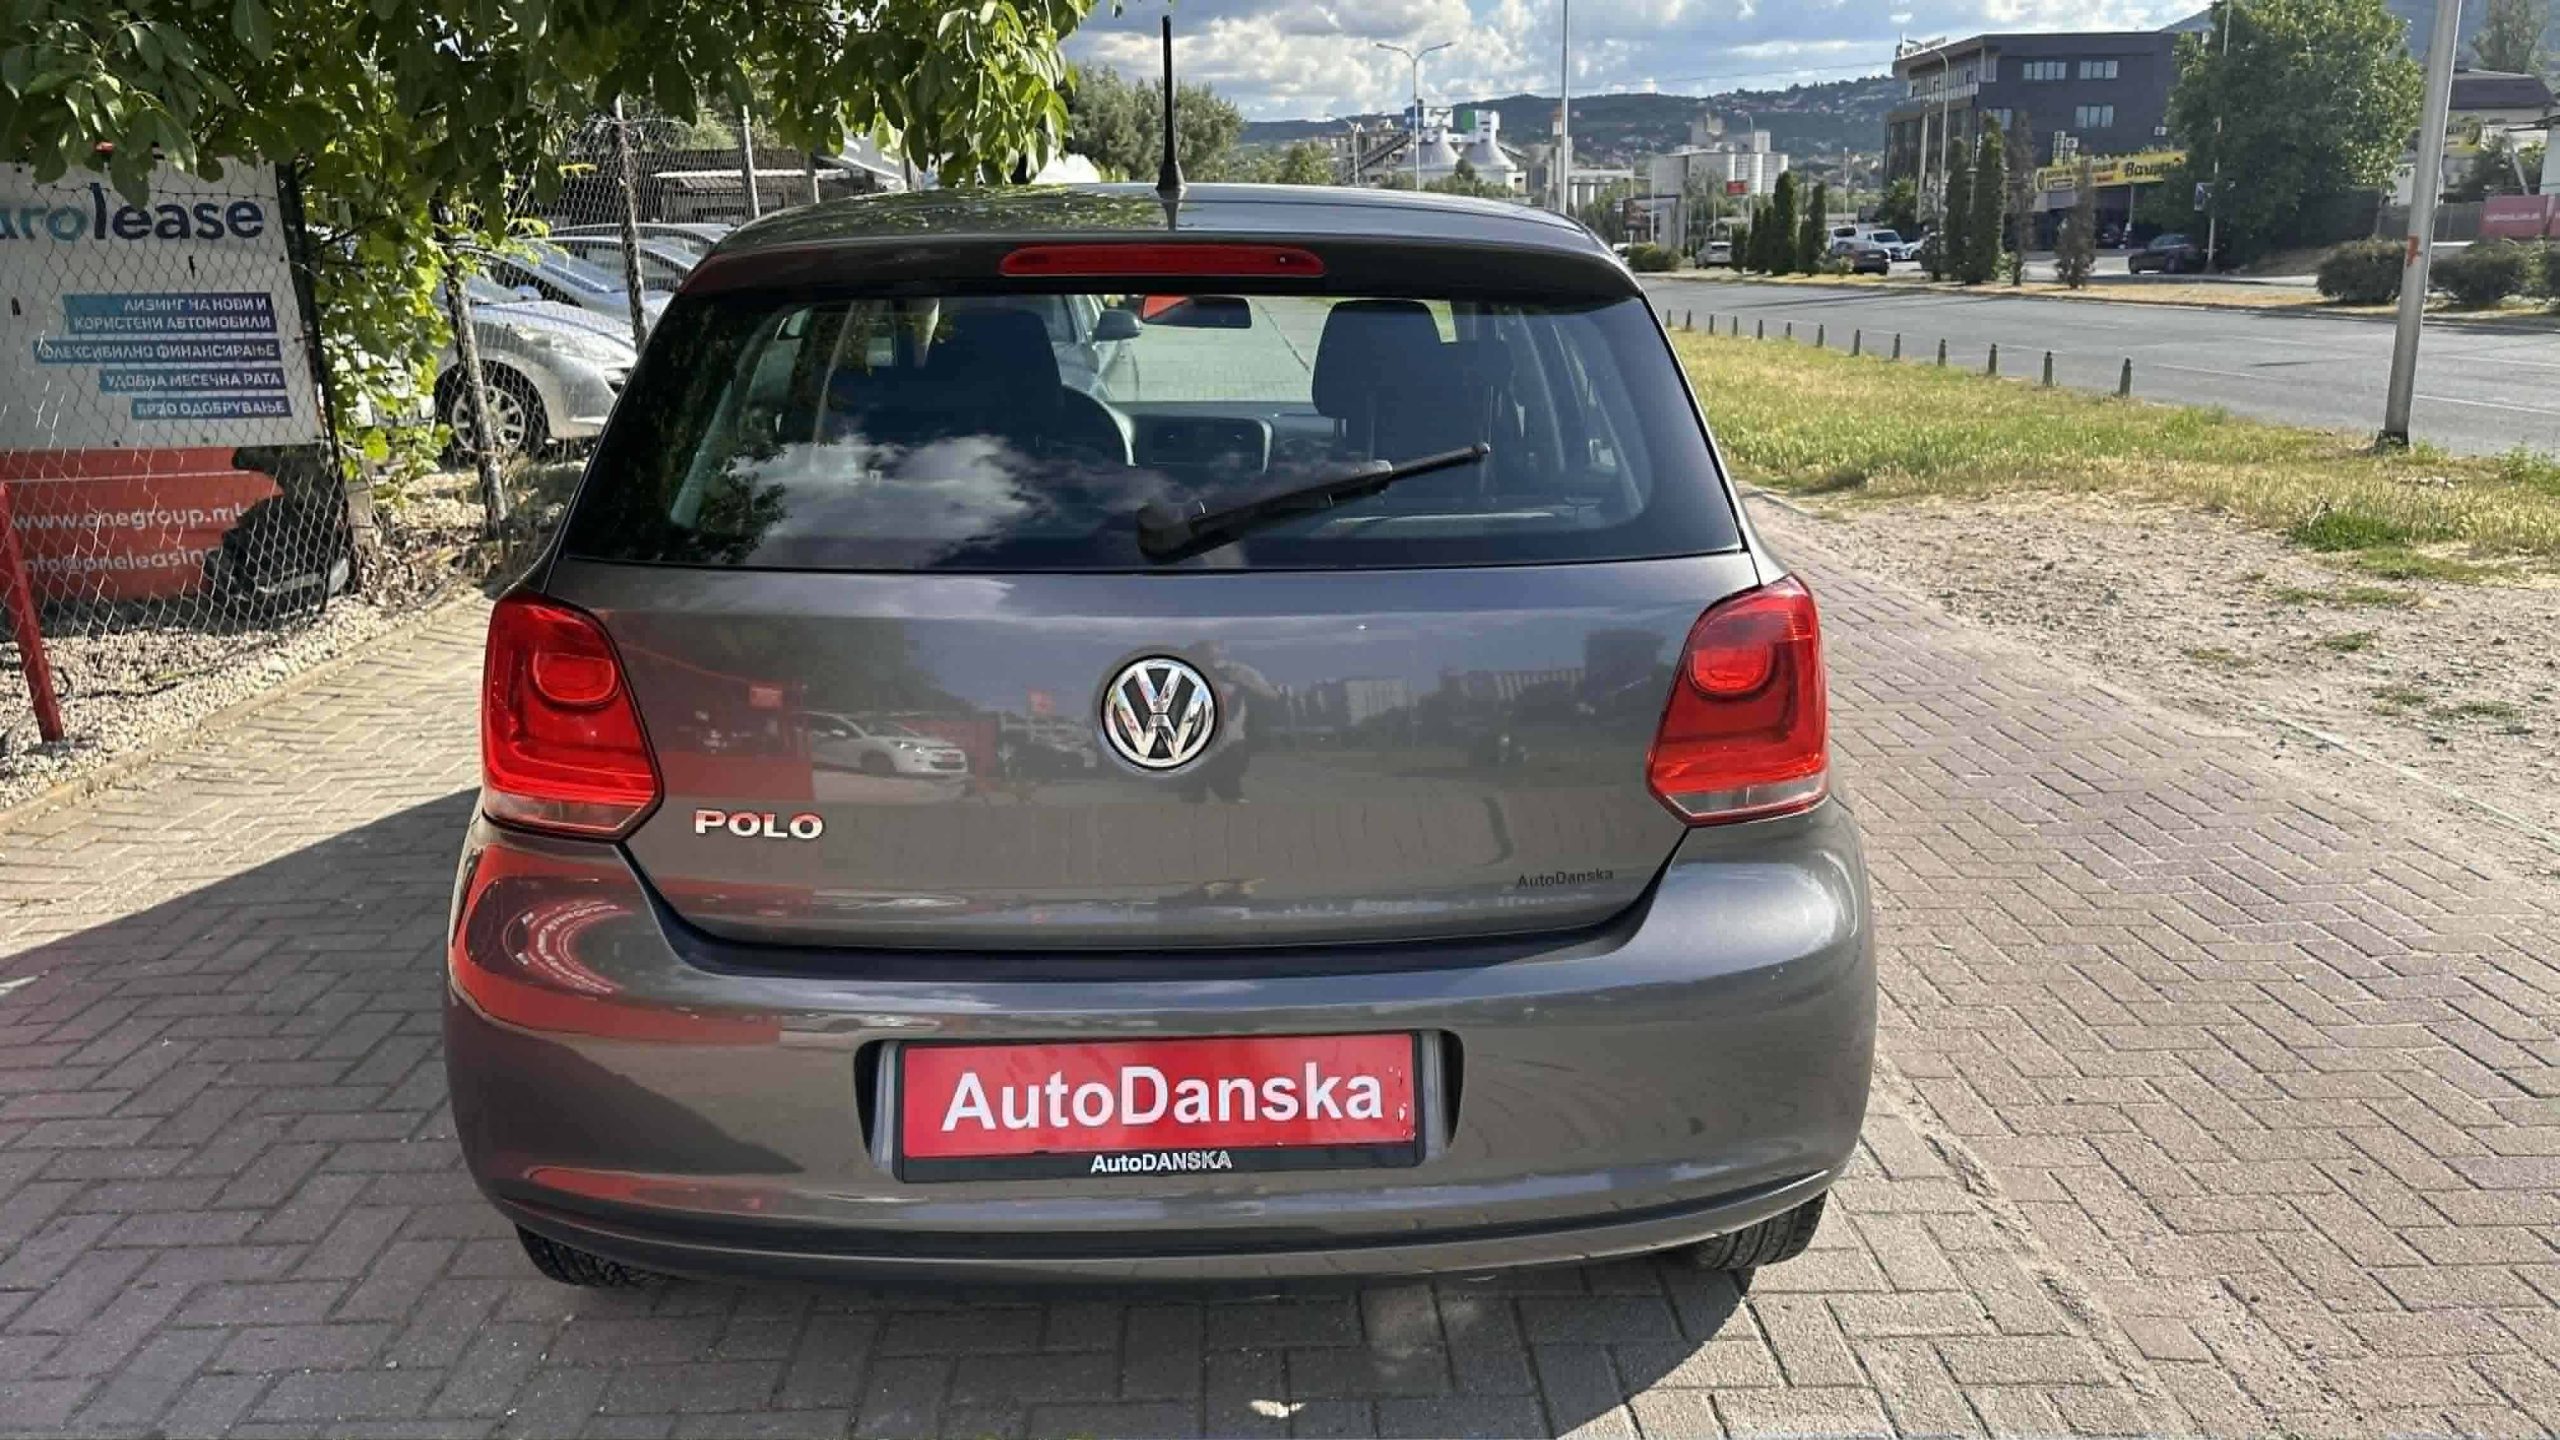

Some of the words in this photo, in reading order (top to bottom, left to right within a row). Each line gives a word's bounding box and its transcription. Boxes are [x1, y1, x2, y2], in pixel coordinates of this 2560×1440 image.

[125, 299, 183, 311] ЛИЗИНГ
[191, 299, 210, 310] НА
[213, 298, 254, 310] НОВИ
[256, 298, 267, 310] И
[74, 317, 163, 330] КОРИСТЕНИ
[167, 316, 271, 329] АВТОМОБИЛИ
[107, 374, 167, 389] УДОБНА
[170, 373, 241, 387] МЕСЕЧНА
[243, 372, 281, 386] РАТА
[180, 401, 286, 416] ОДОБРУВАЊЕ
[695, 808, 823, 839] POLO
[1517, 867, 1614, 889] AutoDanska
[941, 1061, 1384, 1132] AutoDanska
[1090, 1150, 1232, 1174] AutoDANSKA
